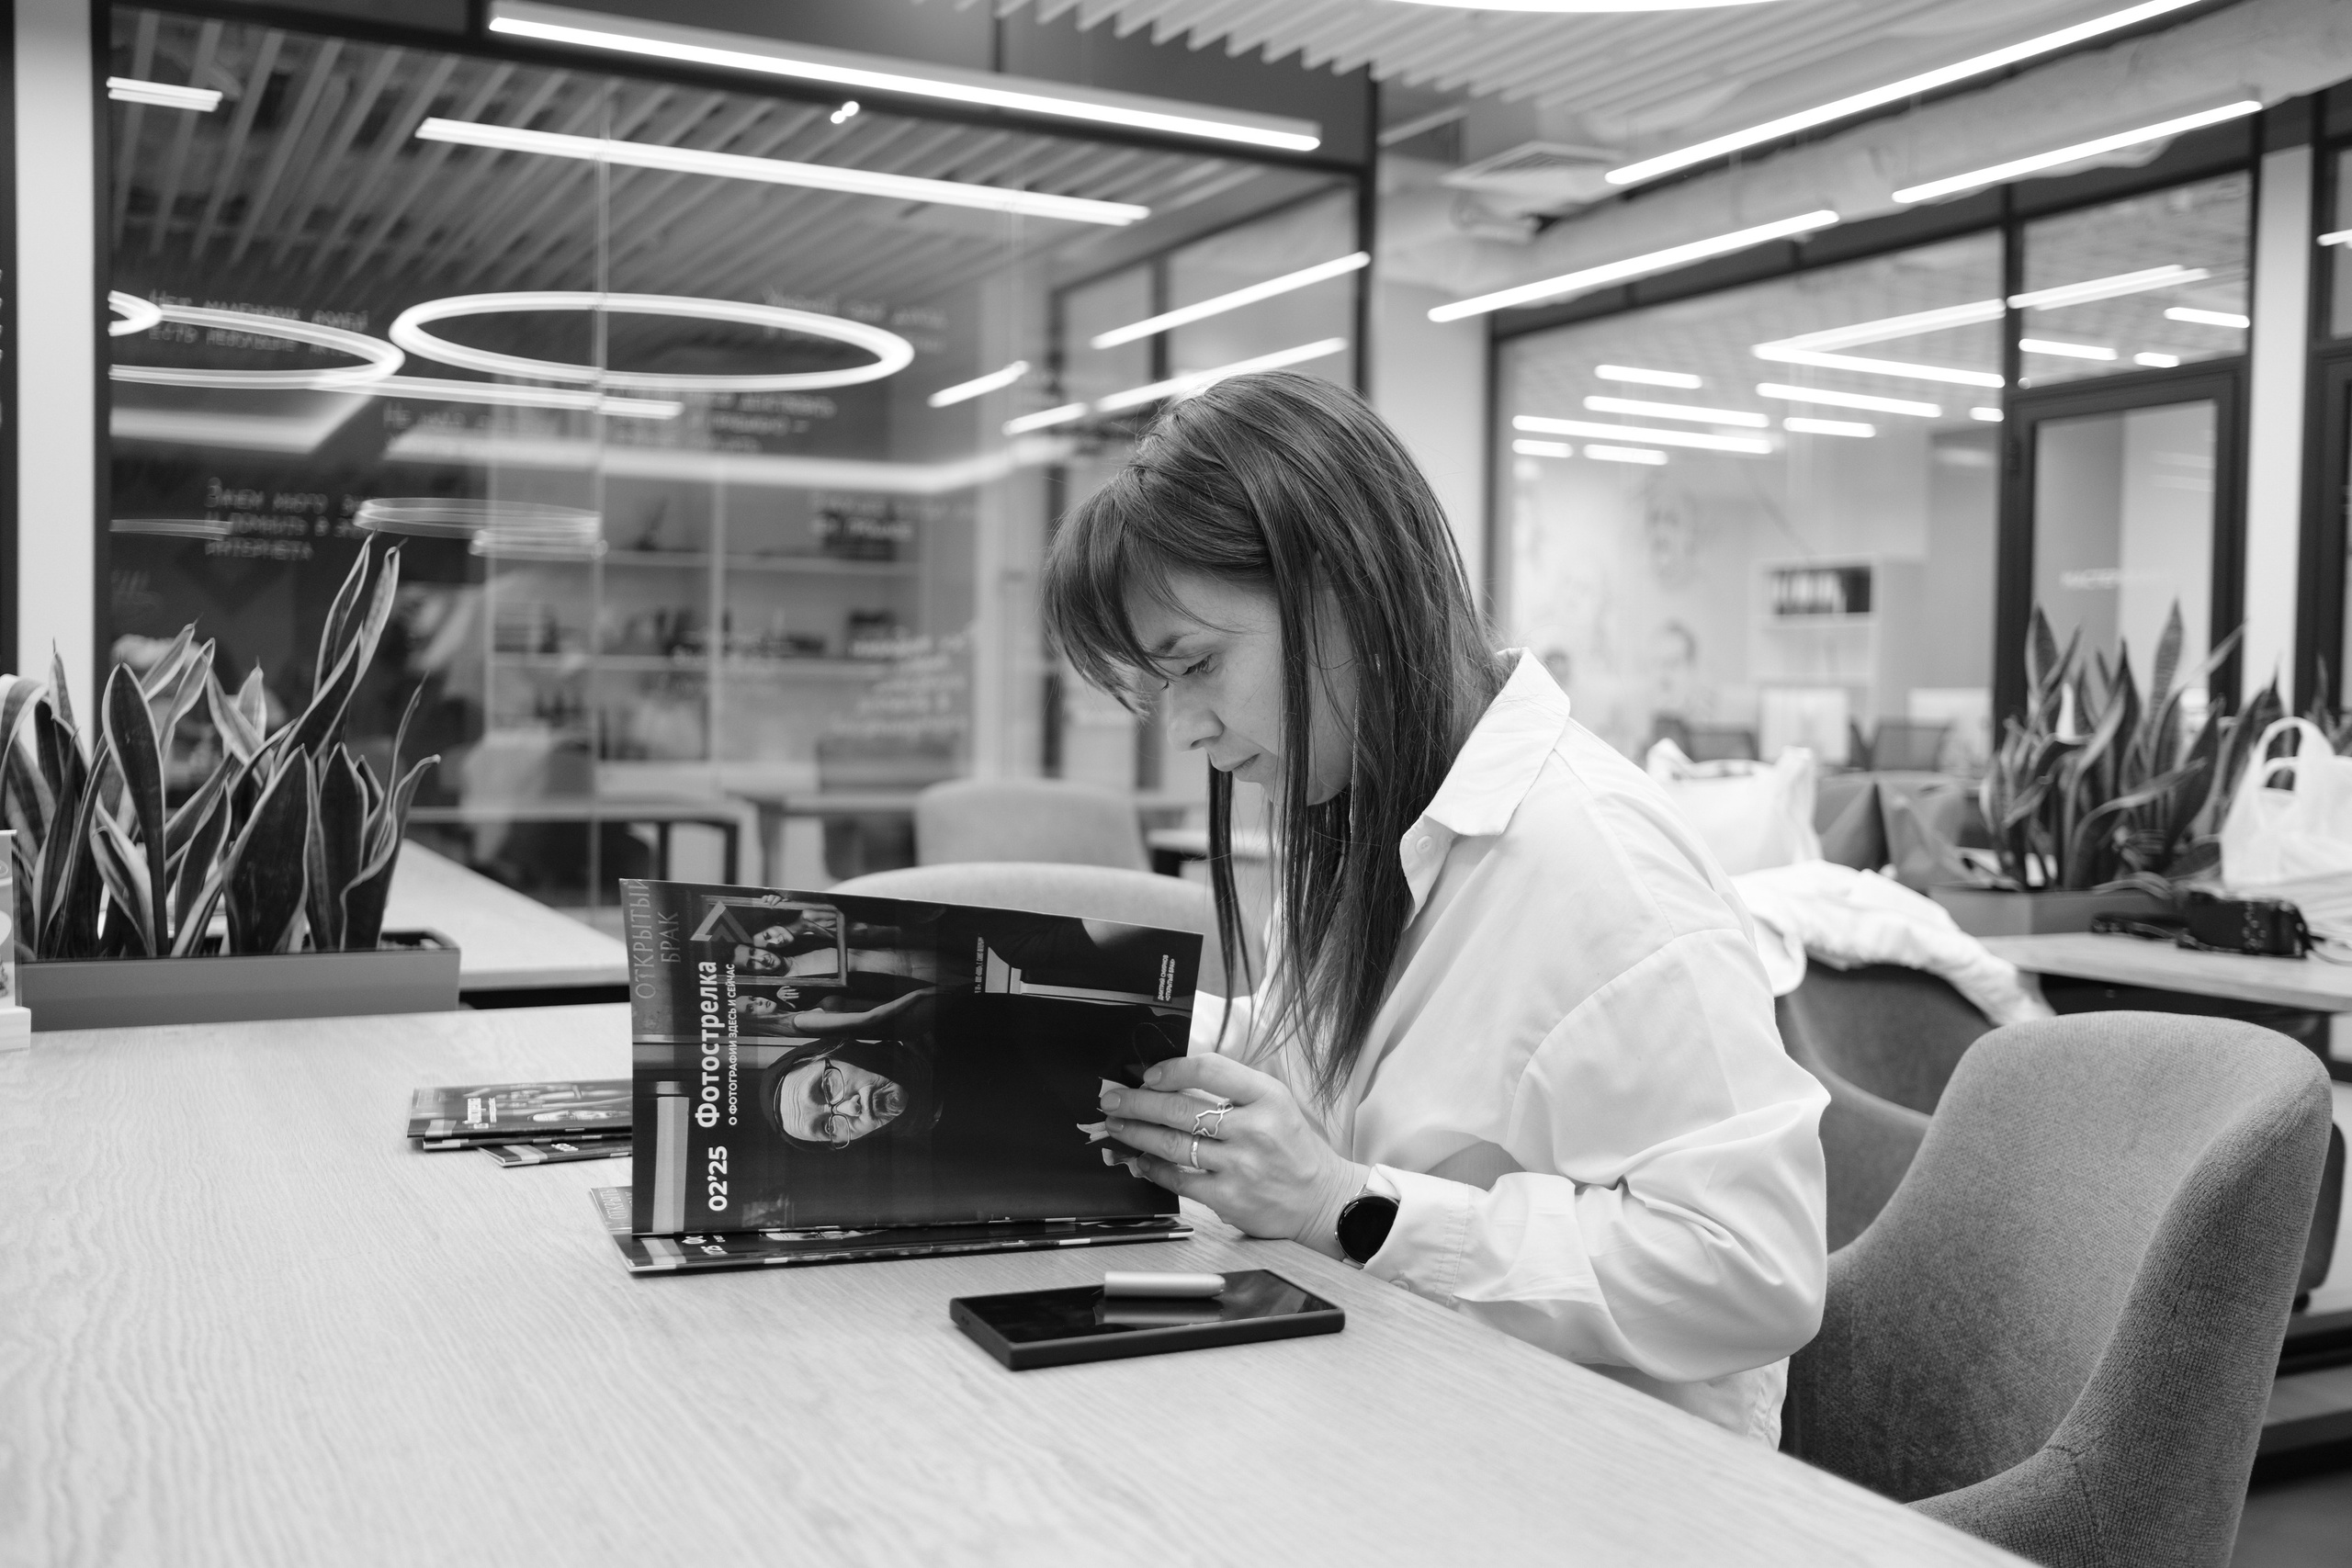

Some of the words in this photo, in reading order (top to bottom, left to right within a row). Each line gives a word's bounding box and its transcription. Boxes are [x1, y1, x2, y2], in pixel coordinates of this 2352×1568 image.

[657, 911, 682, 963] БРАК
[724, 964, 736, 998] СЕЙЧАС
[1160, 954, 1169, 977] СМИРНОВ
[726, 998, 736, 1007] И
[1158, 977, 1166, 1001] ДМИТРИЙ
[727, 1008, 739, 1039] ЗДЕСЬ
[694, 961, 724, 1128] Фотострелка
[728, 1040, 739, 1115] ФОТОГРАФИИ
[729, 1117, 738, 1125] О
[707, 1145, 729, 1212] 02'25
